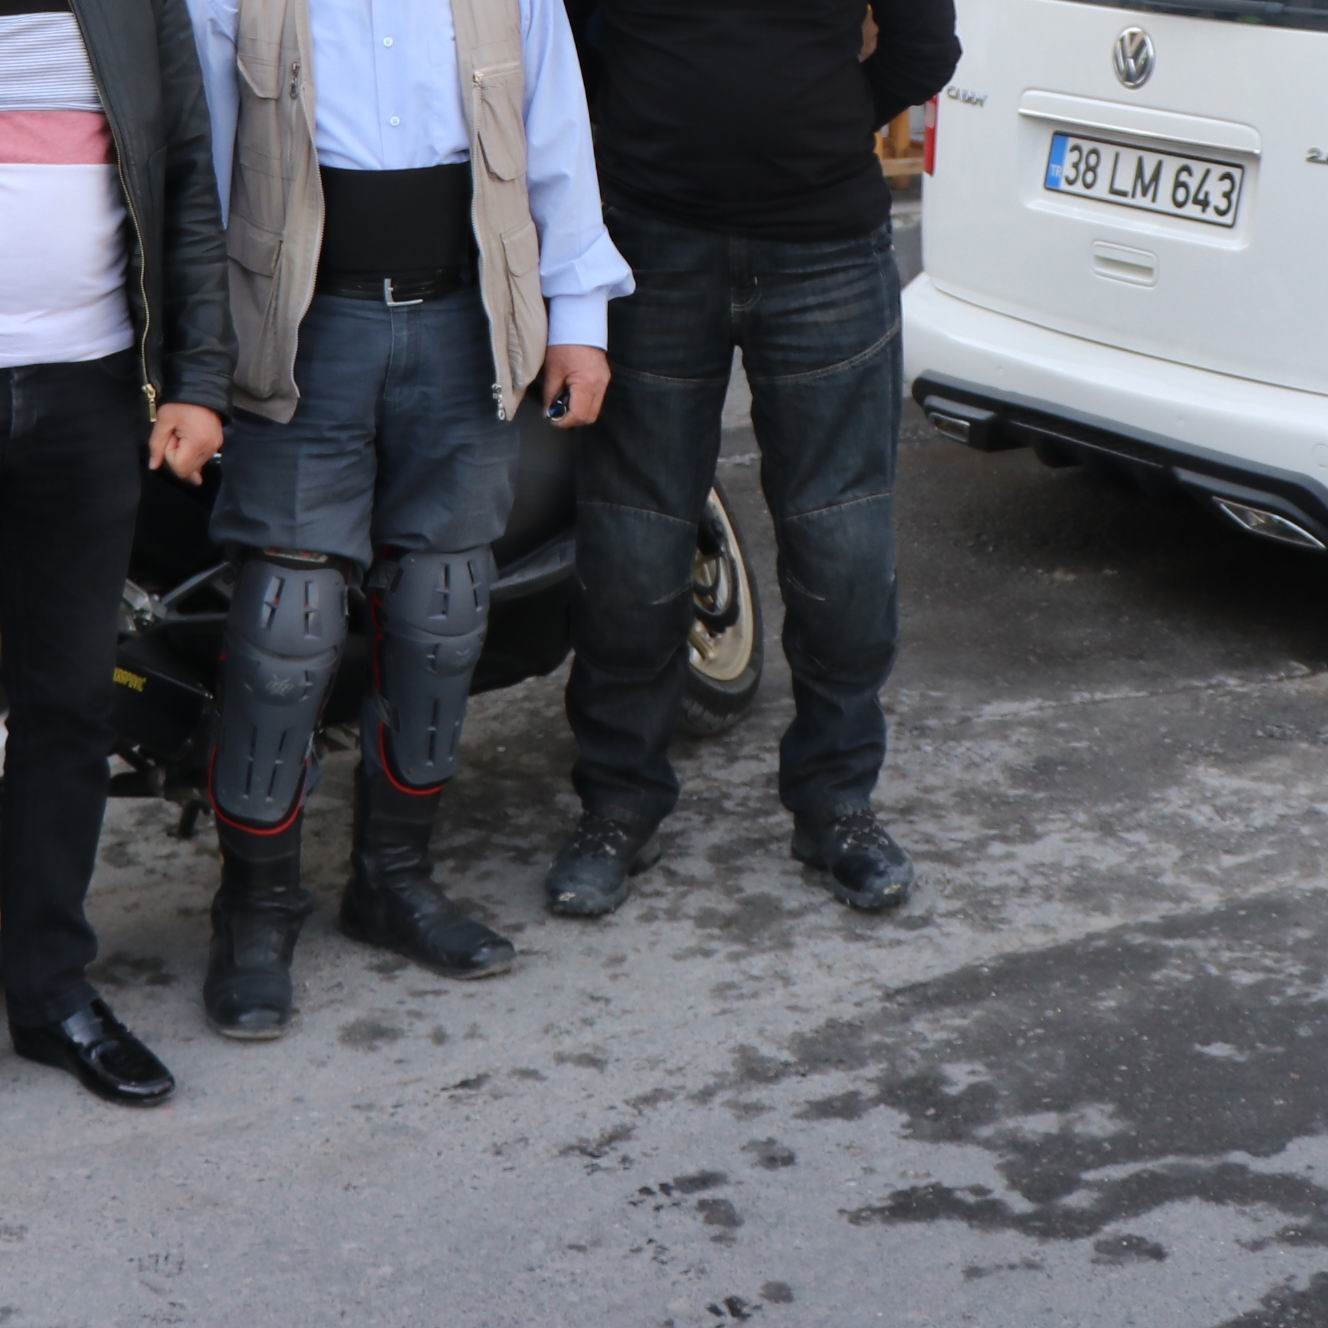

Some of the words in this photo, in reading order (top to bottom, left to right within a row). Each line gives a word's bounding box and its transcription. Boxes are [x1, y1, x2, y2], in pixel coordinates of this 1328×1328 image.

[1064, 142, 1102, 191] 38
[1108, 150, 1164, 204] LM
[1171, 162, 1238, 218] 643
